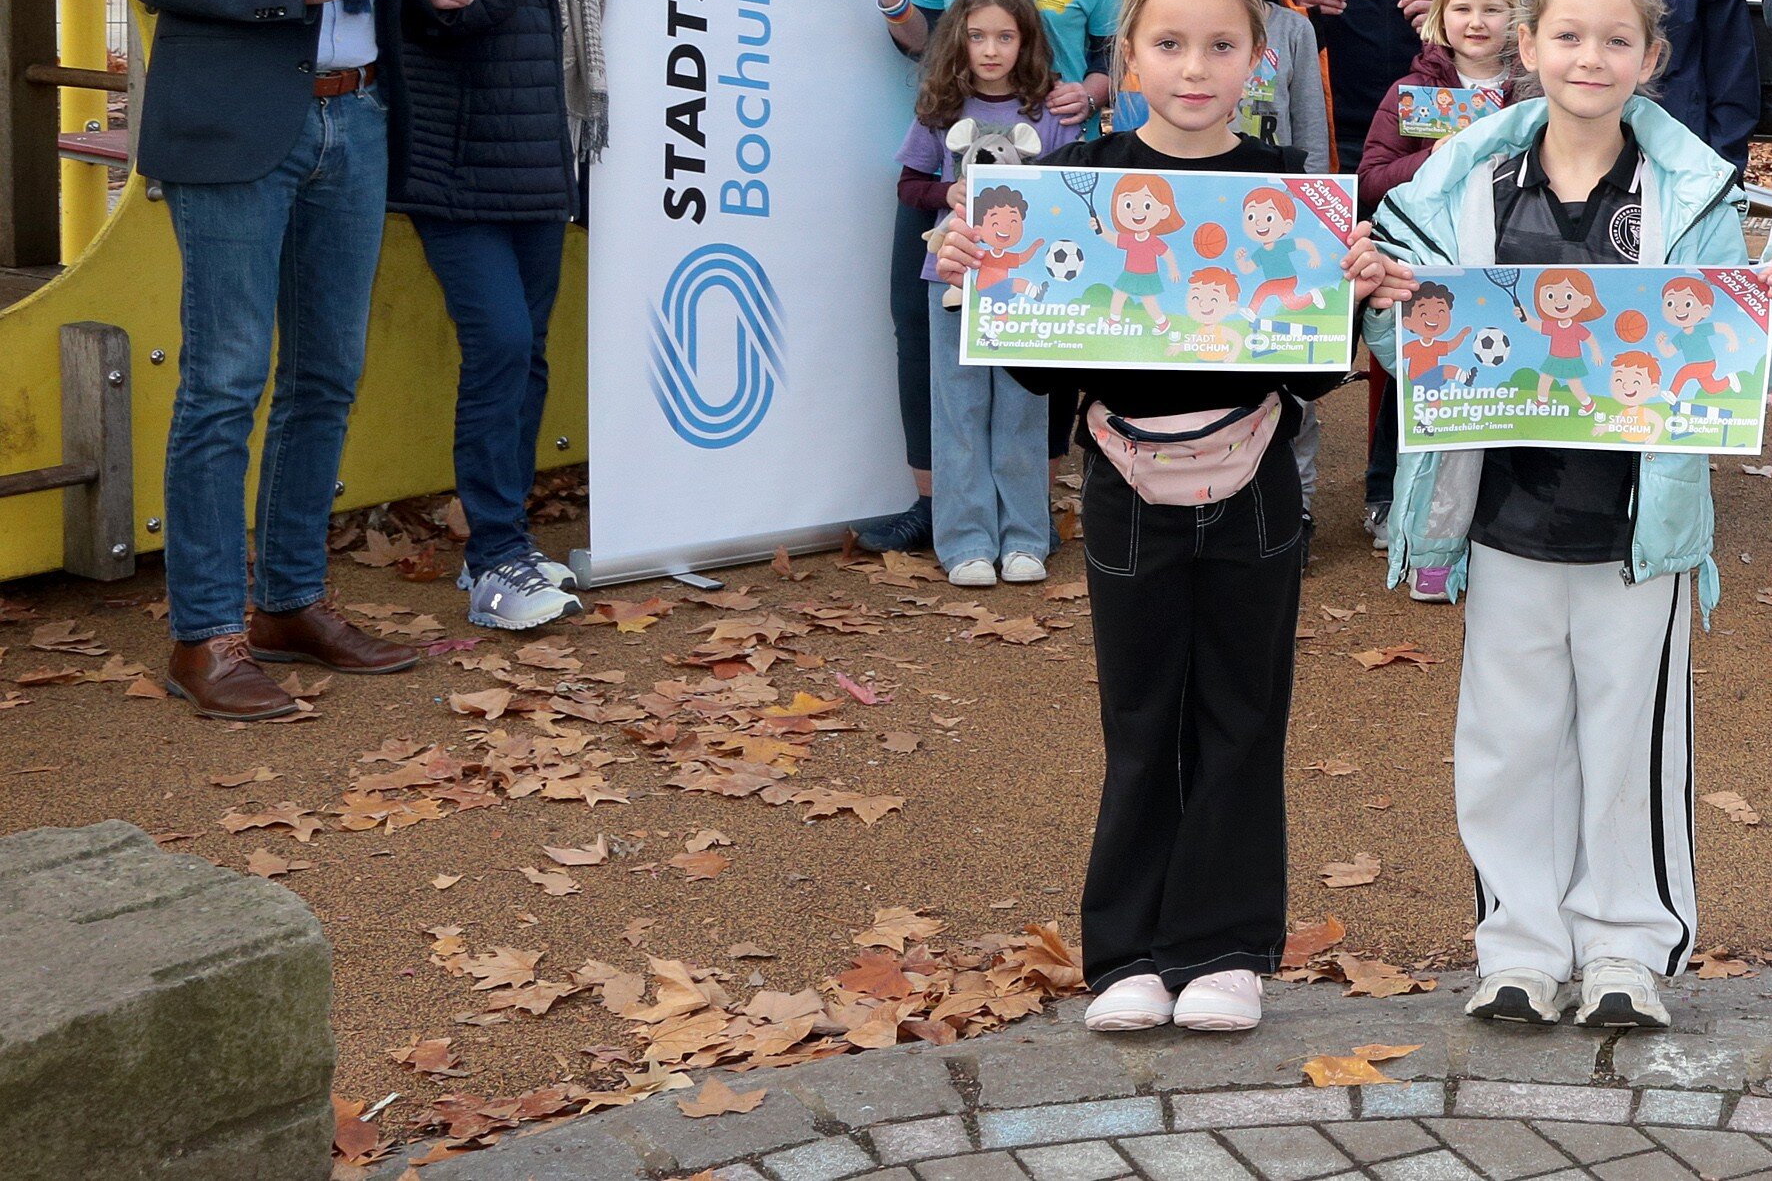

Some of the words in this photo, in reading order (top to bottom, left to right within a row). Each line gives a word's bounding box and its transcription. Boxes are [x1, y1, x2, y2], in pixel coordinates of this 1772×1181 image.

[1313, 180, 1352, 219] Schuljahr
[1300, 183, 1350, 232] 2025/2026
[1730, 270, 1768, 303] Schuljahr
[1717, 272, 1767, 316] 2025/2026
[978, 296, 1091, 317] Bochumer
[976, 315, 1143, 339] Sportgutschein
[976, 338, 989, 348] für
[1184, 333, 1216, 343] STADT
[1271, 334, 1347, 343] STADTSPORTBUND
[1183, 342, 1230, 353] BOCHUM
[1270, 342, 1304, 351] Bochum
[1412, 383, 1518, 402] Bochumer
[1412, 399, 1570, 425] Sportgutschein
[1608, 415, 1638, 424] STADT
[1689, 417, 1759, 426] STADTSPORTBUND
[1608, 424, 1651, 434] BOCHUM
[1688, 424, 1719, 433] Bochum
